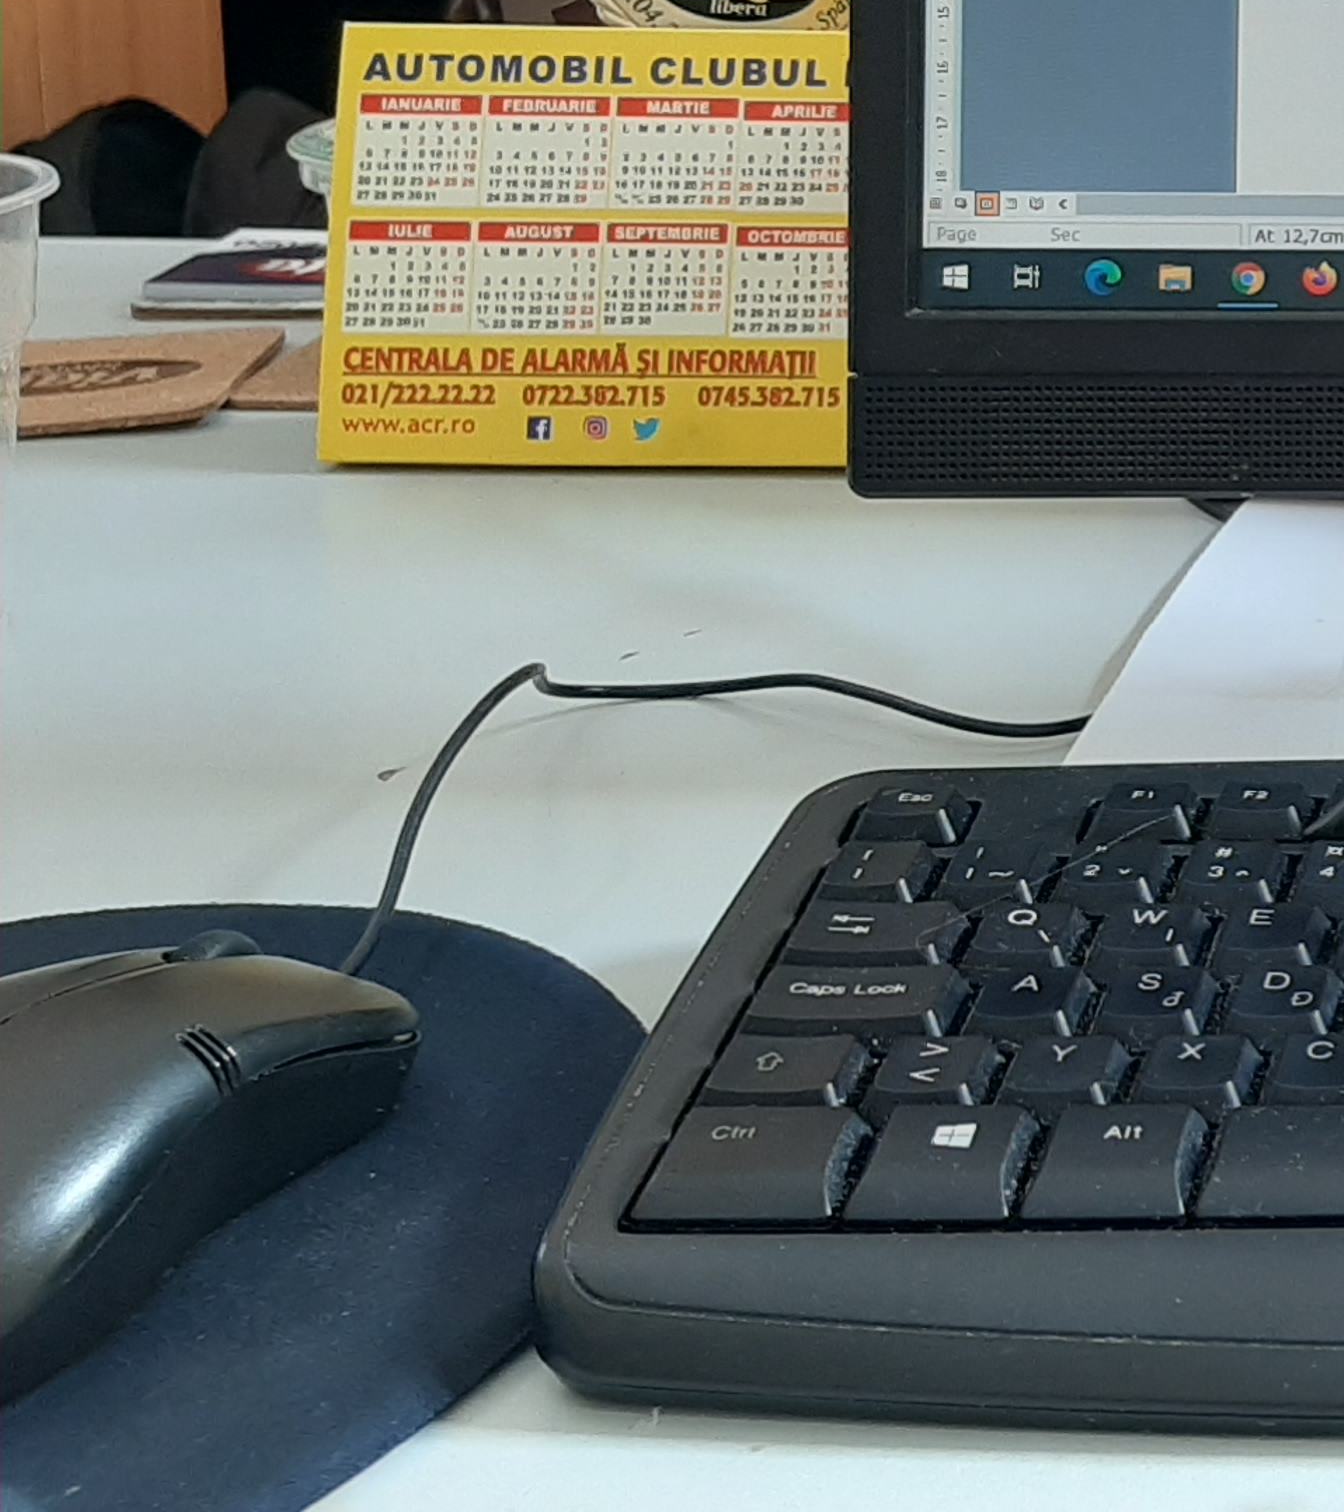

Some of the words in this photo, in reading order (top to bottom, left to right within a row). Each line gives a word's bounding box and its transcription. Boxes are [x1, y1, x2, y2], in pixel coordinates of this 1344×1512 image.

[363, 53, 634, 84] AUTOMOBIL
[649, 57, 828, 88] CLUBUL
[381, 97, 462, 113] IANUARIE
[502, 99, 597, 115] FEBRUARIE
[646, 99, 710, 116] MARTIE
[771, 104, 838, 120] APRILIE
[388, 223, 433, 239] IULIE
[504, 225, 574, 240] AUGUST
[615, 225, 721, 241] SEPTEMBRIE
[747, 230, 847, 246] OCTOMBRIE
[936, 226, 978, 244] Page
[1050, 226, 1081, 243] Sec
[1254, 229, 1276, 244] At
[1283, 229, 1344, 247] 12,7cm
[343, 347, 473, 374] CENTRALA
[480, 349, 515, 374] DE
[521, 342, 630, 375] ALARMĂ
[341, 383, 496, 406] 021/222.22.22
[522, 385, 666, 407] 0722.382.715
[698, 386, 841, 408] 0745.382.715
[341, 417, 476, 436] www.acr.ro
[898, 792, 934, 804] Esc
[789, 982, 845, 997] Caps
[854, 981, 907, 996] Lock
[711, 1124, 758, 1140] Ctrl
[1103, 1124, 1144, 1141] Alt
